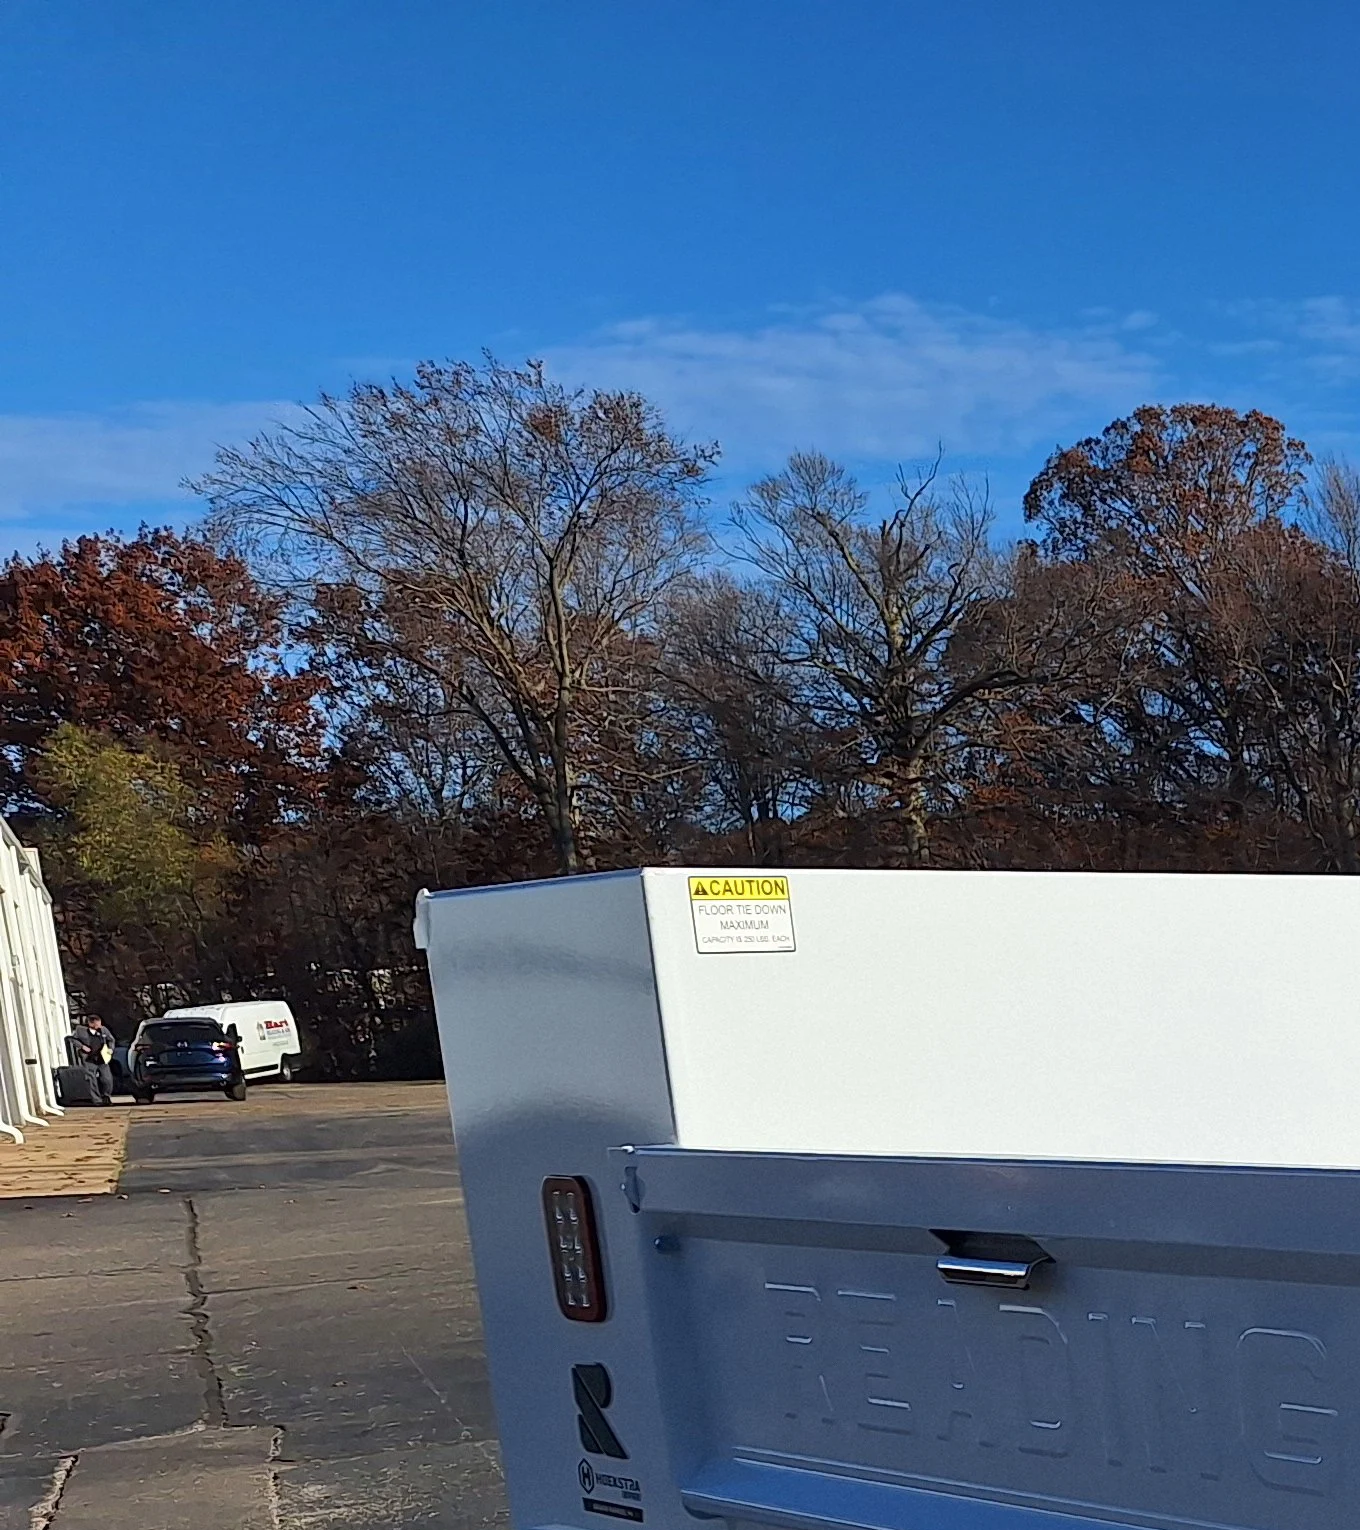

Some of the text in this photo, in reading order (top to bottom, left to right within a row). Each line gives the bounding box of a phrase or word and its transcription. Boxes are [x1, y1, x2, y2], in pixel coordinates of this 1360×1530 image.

[709, 880, 786, 896] CAUTION
[698, 904, 787, 916] FLOOR TIE DOWN
[720, 920, 769, 930] MAXIMUM
[763, 1281, 1340, 1497] READING
